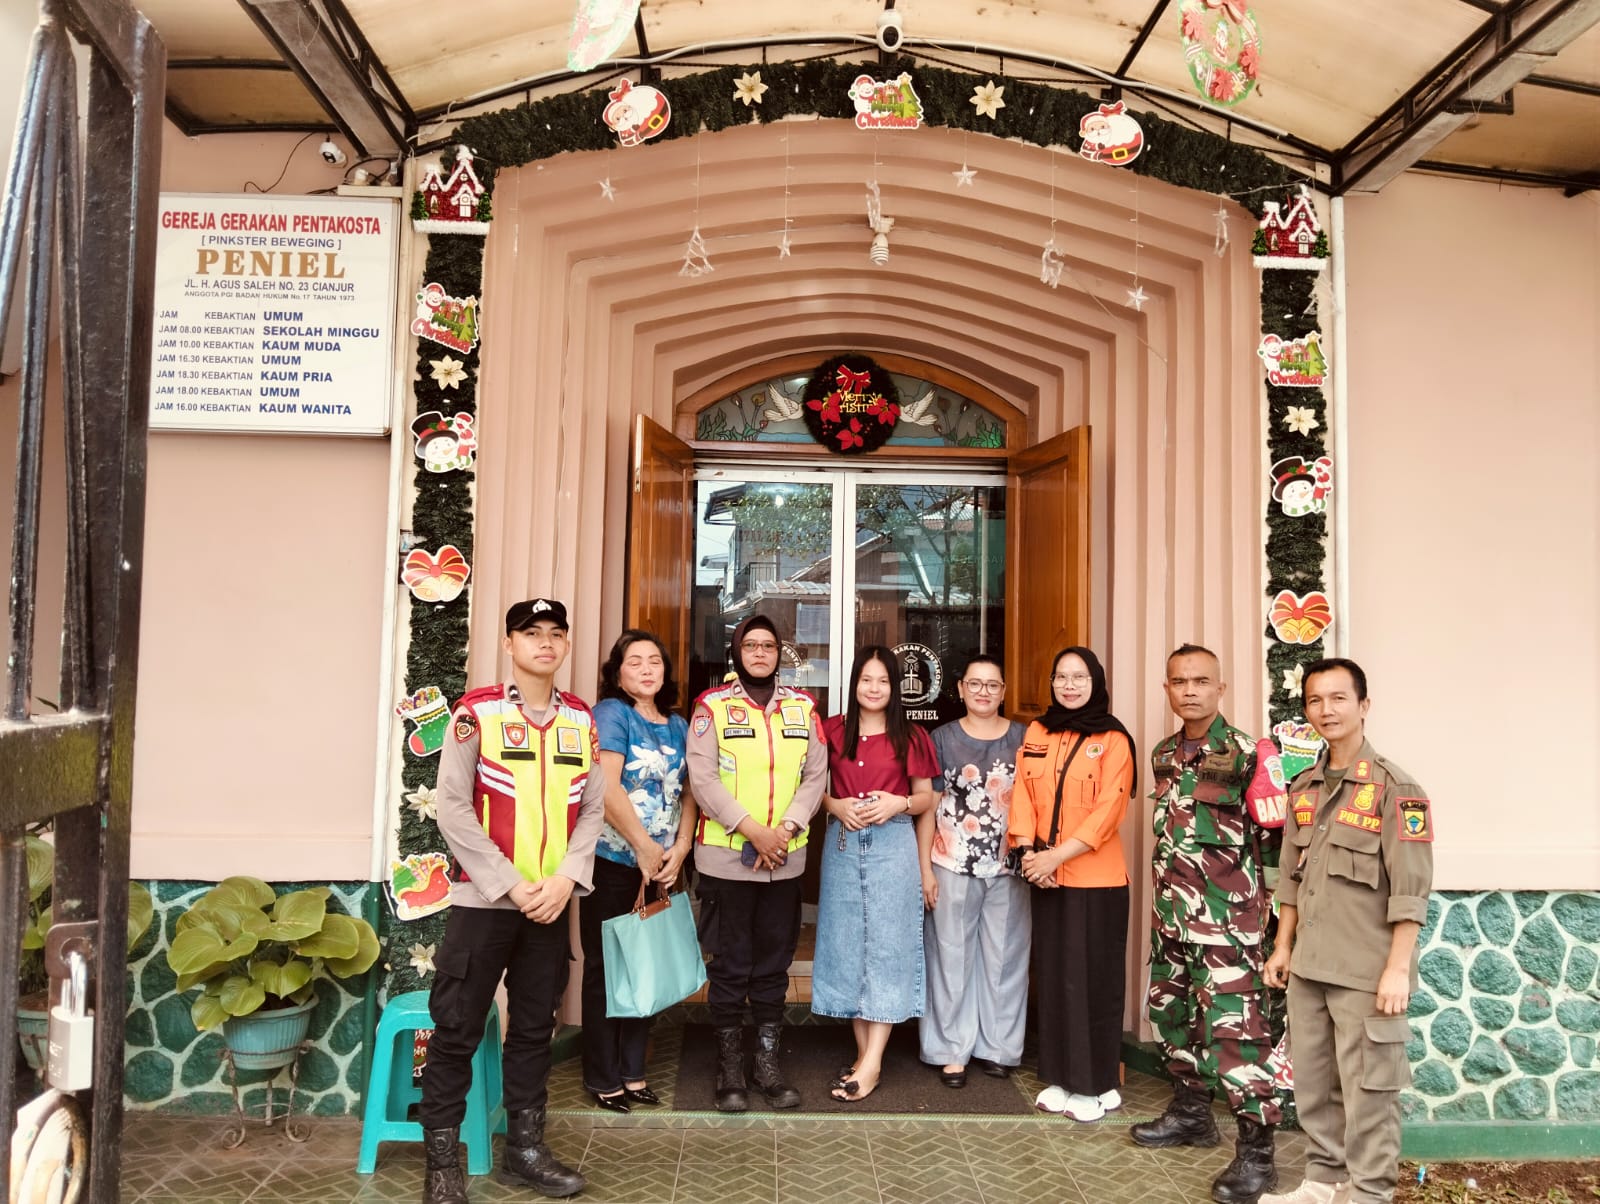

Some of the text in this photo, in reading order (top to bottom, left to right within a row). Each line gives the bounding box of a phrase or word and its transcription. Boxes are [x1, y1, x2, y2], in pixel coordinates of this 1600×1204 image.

[857, 111, 917, 127] Christmas
[162, 211, 381, 234] GEREJA GERAKAN PENTAKOSTA
[208, 236, 267, 246] PINKSTER
[271, 237, 334, 248] BEWEGING
[196, 249, 346, 278] PENIEL
[184, 279, 354, 292] JL. H. AGUS SALEH NO. 23 CIANJUR
[160, 311, 303, 321] JAM KEBAKTIAN UMUM
[179, 326, 202, 334] 08.00
[204, 326, 255, 335] KEBAKTIAN
[263, 326, 323, 337] SEKOLAH
[327, 328, 380, 338] MINGGU
[158, 340, 341, 352] JAM 10.00 KEBAKTIAN KAUM MUDA
[179, 355, 200, 363] 16.30
[202, 356, 254, 365] KEBAKTIAN
[262, 355, 301, 365] UMUM
[156, 371, 332, 382] JAM 18.30 KEBAKTIAN KAUM PRIA
[1270, 370, 1323, 385] Christmas
[156, 387, 300, 397] JAM 18.00 KEBAKTIAN UMUM
[155, 402, 351, 415] JAM 16.00 KEBAKTIAN KAUM WANITA
[906, 709, 939, 721] PENIEL
[1338, 810, 1381, 830] POL PP
